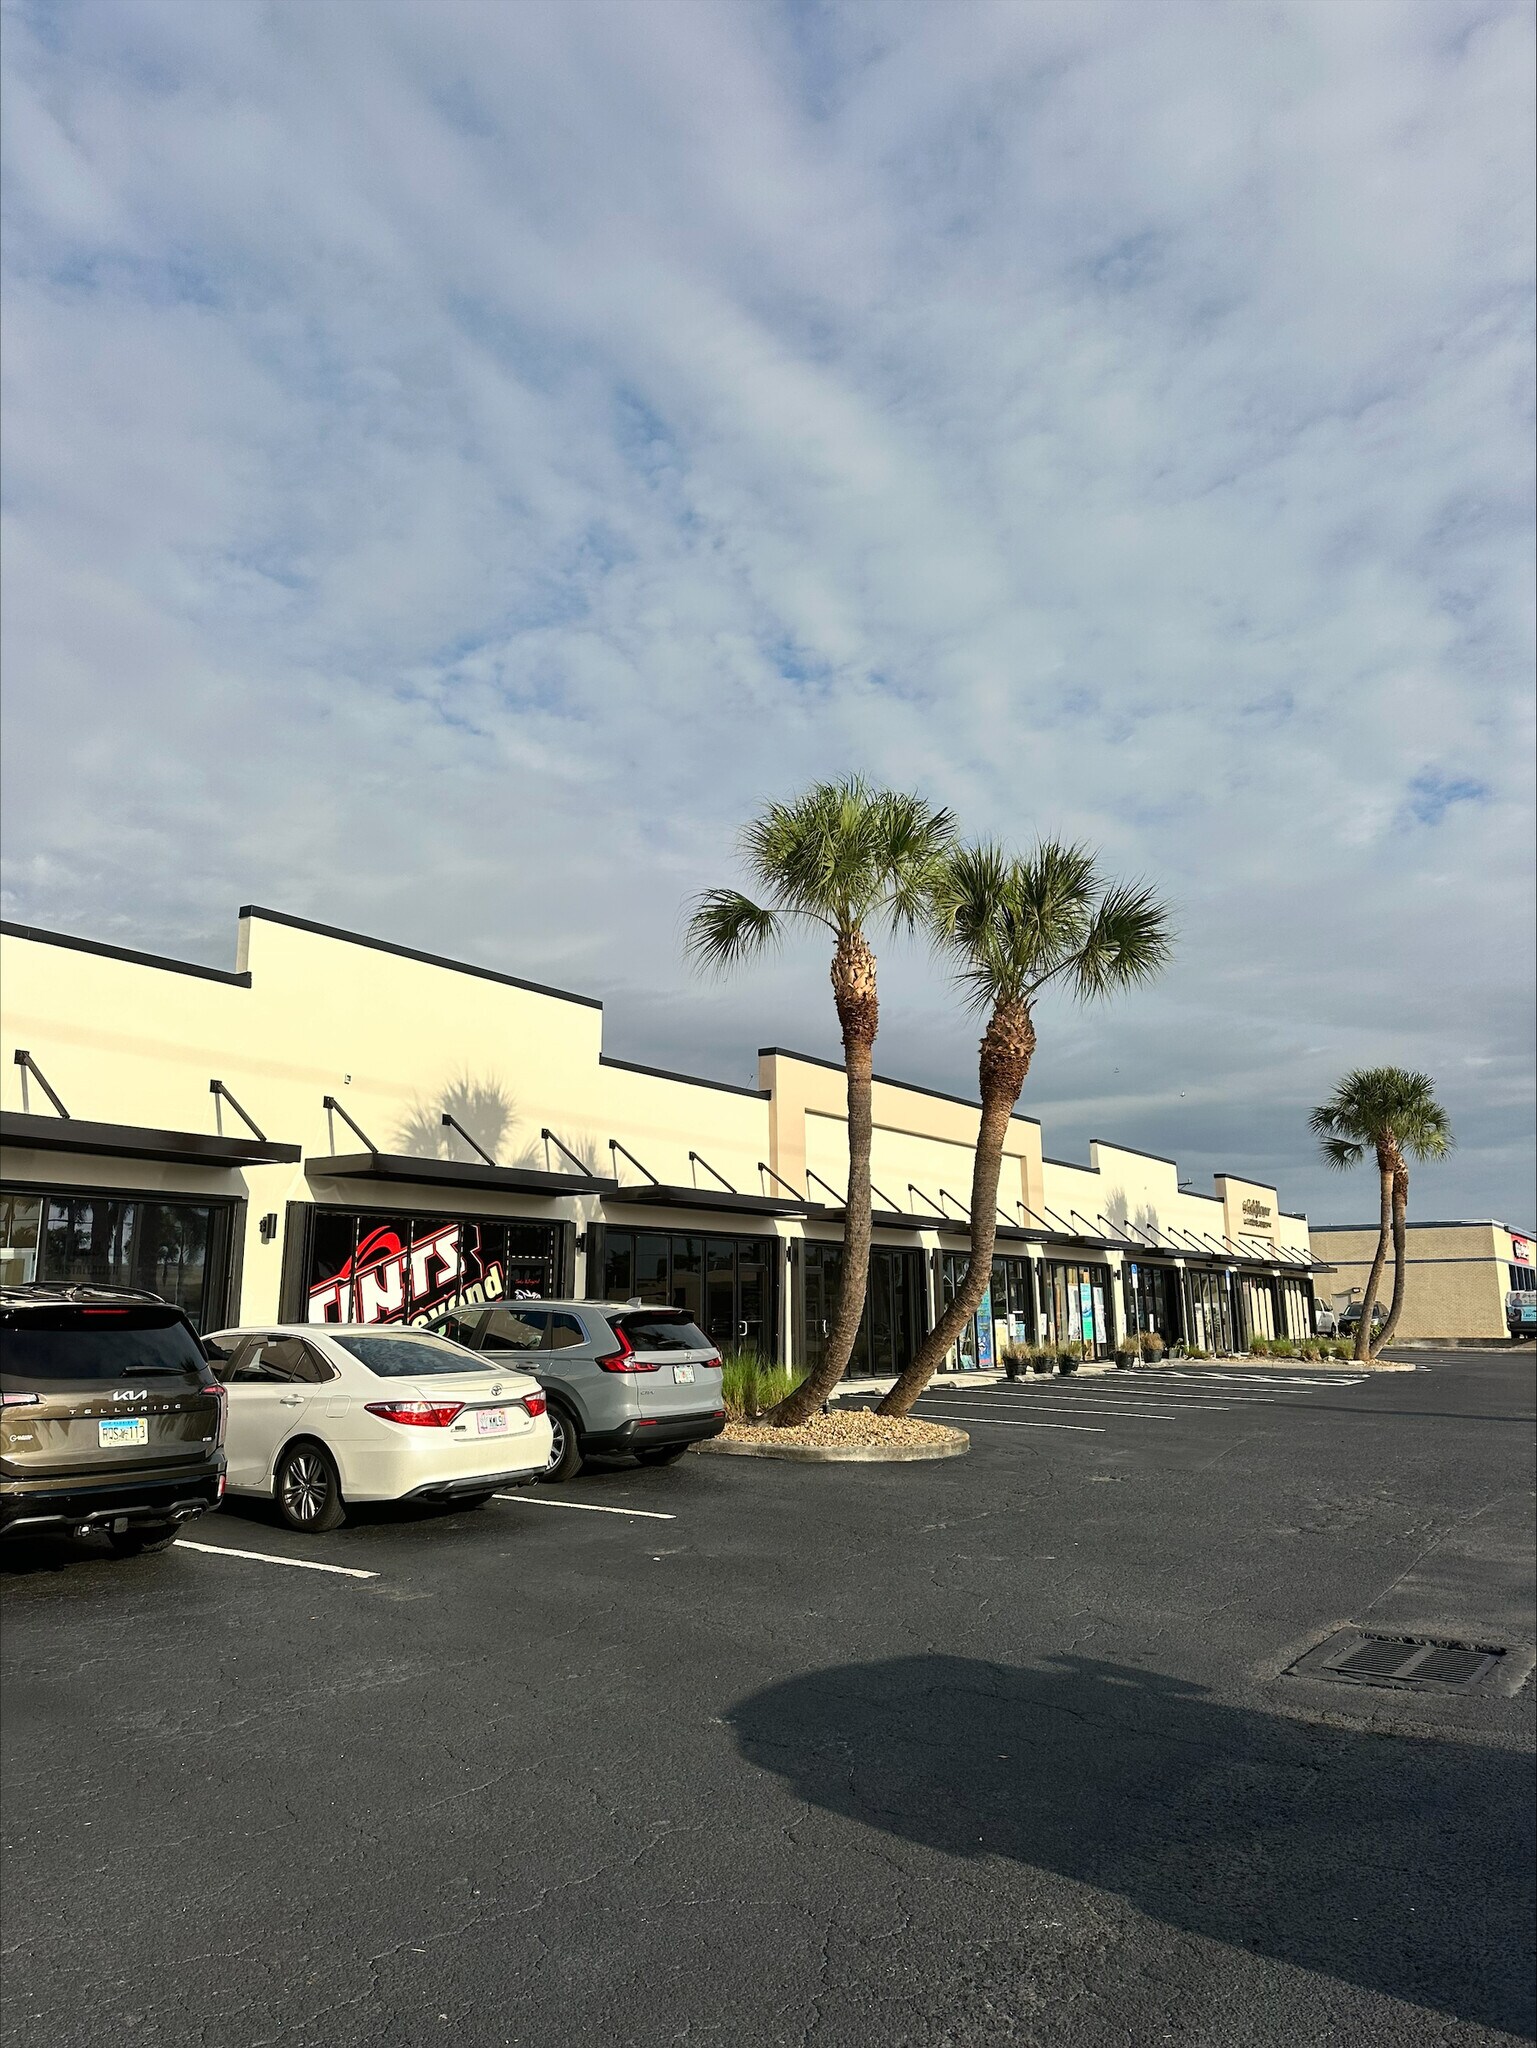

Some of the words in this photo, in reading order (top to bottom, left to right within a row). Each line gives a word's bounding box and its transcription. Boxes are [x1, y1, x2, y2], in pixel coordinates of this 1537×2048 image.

[308, 1230, 466, 1324] TINTS
[393, 1265, 503, 1326] eyond
[69, 1403, 182, 1415] TELLURIDE
